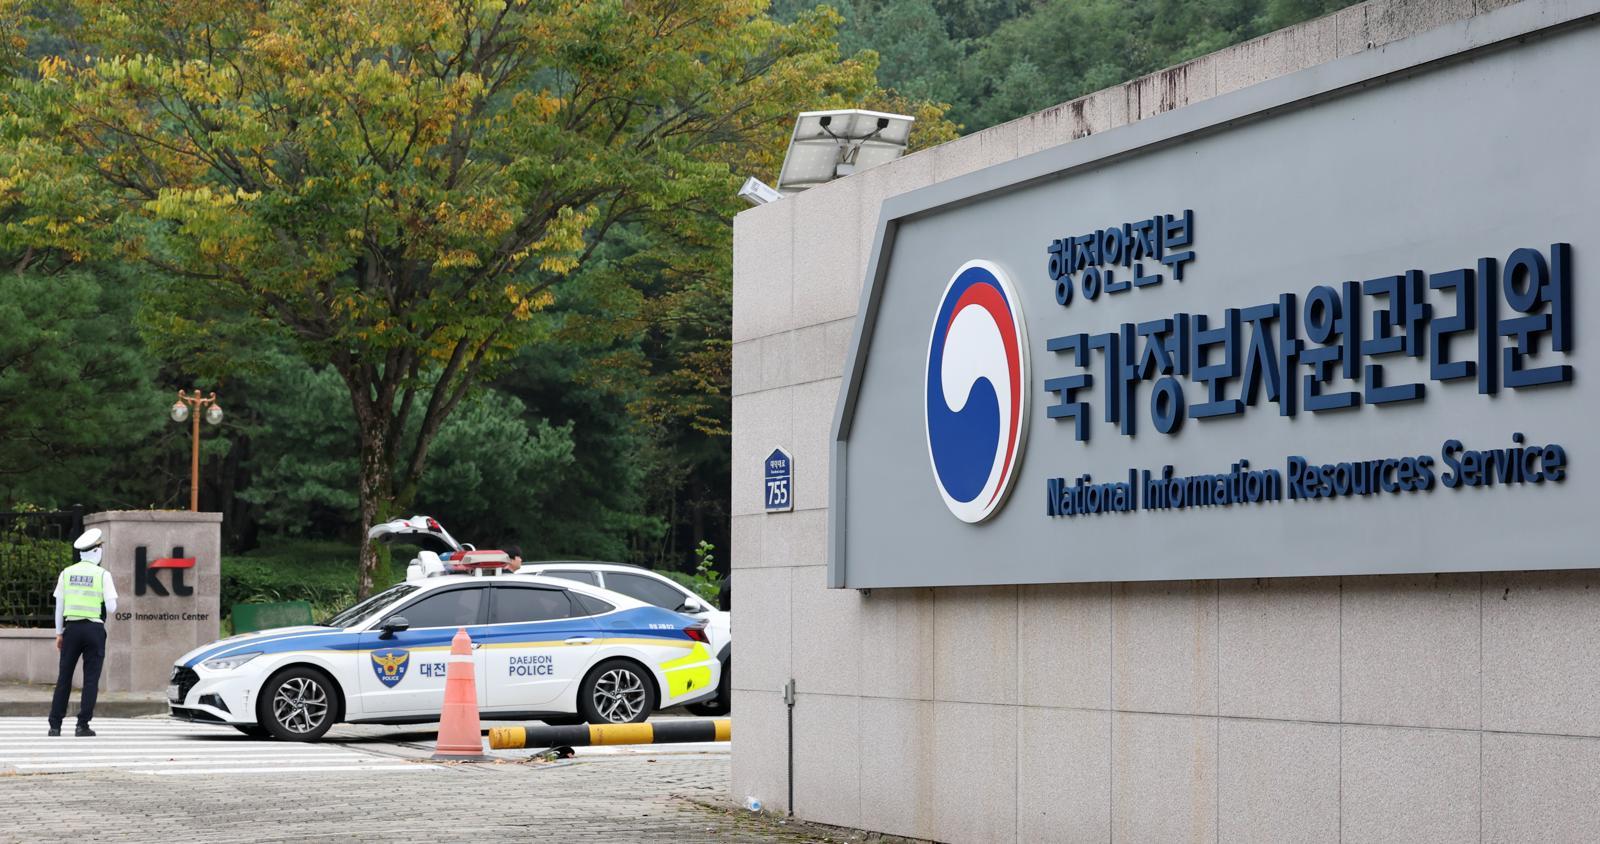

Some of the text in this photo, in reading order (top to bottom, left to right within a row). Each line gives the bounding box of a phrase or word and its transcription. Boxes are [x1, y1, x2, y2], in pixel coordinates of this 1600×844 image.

[1047, 209, 1195, 306] 행정안전부
[1044, 242, 1573, 442] 국가정보자원관리원
[767, 480, 788, 505] 755
[1047, 432, 1567, 517] National Information Resources Service
[135, 546, 196, 597] kt
[115, 612, 209, 621] OSP Innovation Center
[509, 655, 552, 665] DAEJEON
[509, 664, 553, 676] POLICE
